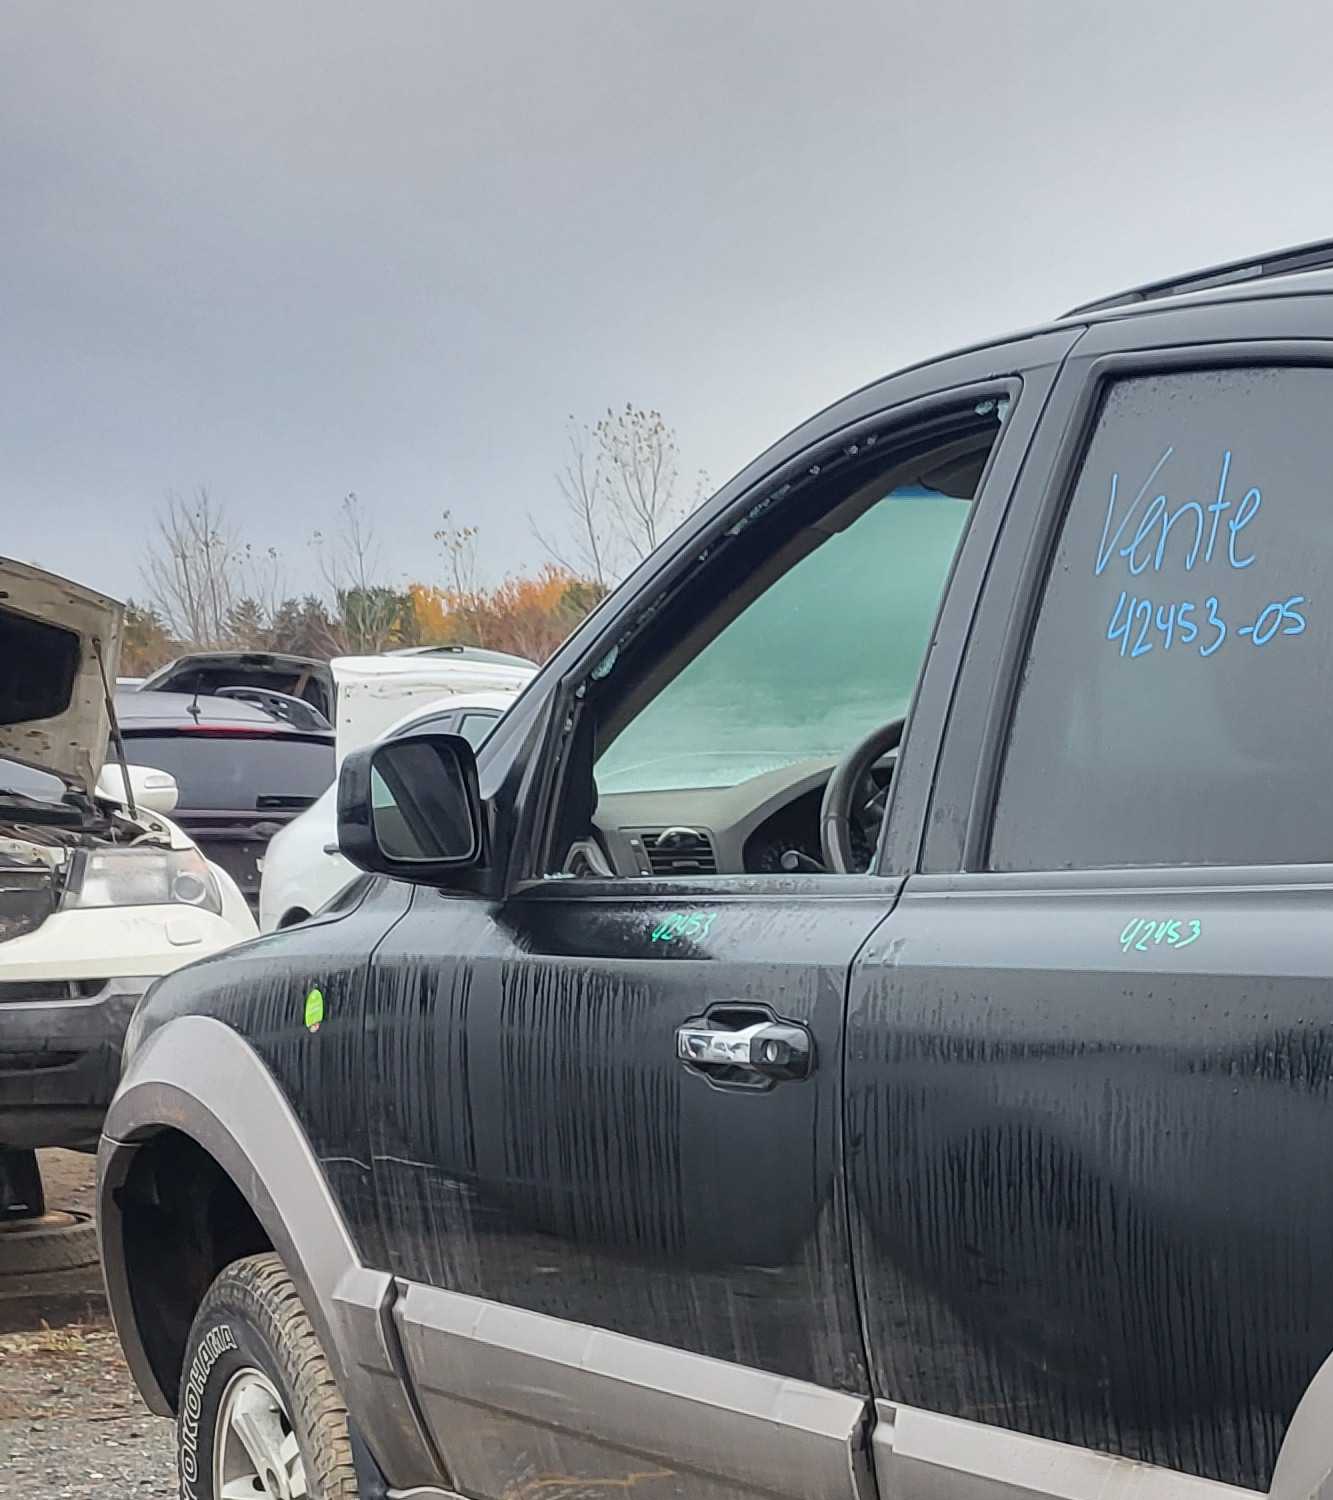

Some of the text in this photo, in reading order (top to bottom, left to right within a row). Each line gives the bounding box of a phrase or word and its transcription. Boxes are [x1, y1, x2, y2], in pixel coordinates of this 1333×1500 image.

[1094, 447, 1262, 576] Vente
[1106, 591, 1306, 657] 42453-05
[1119, 917, 1202, 953] 42453
